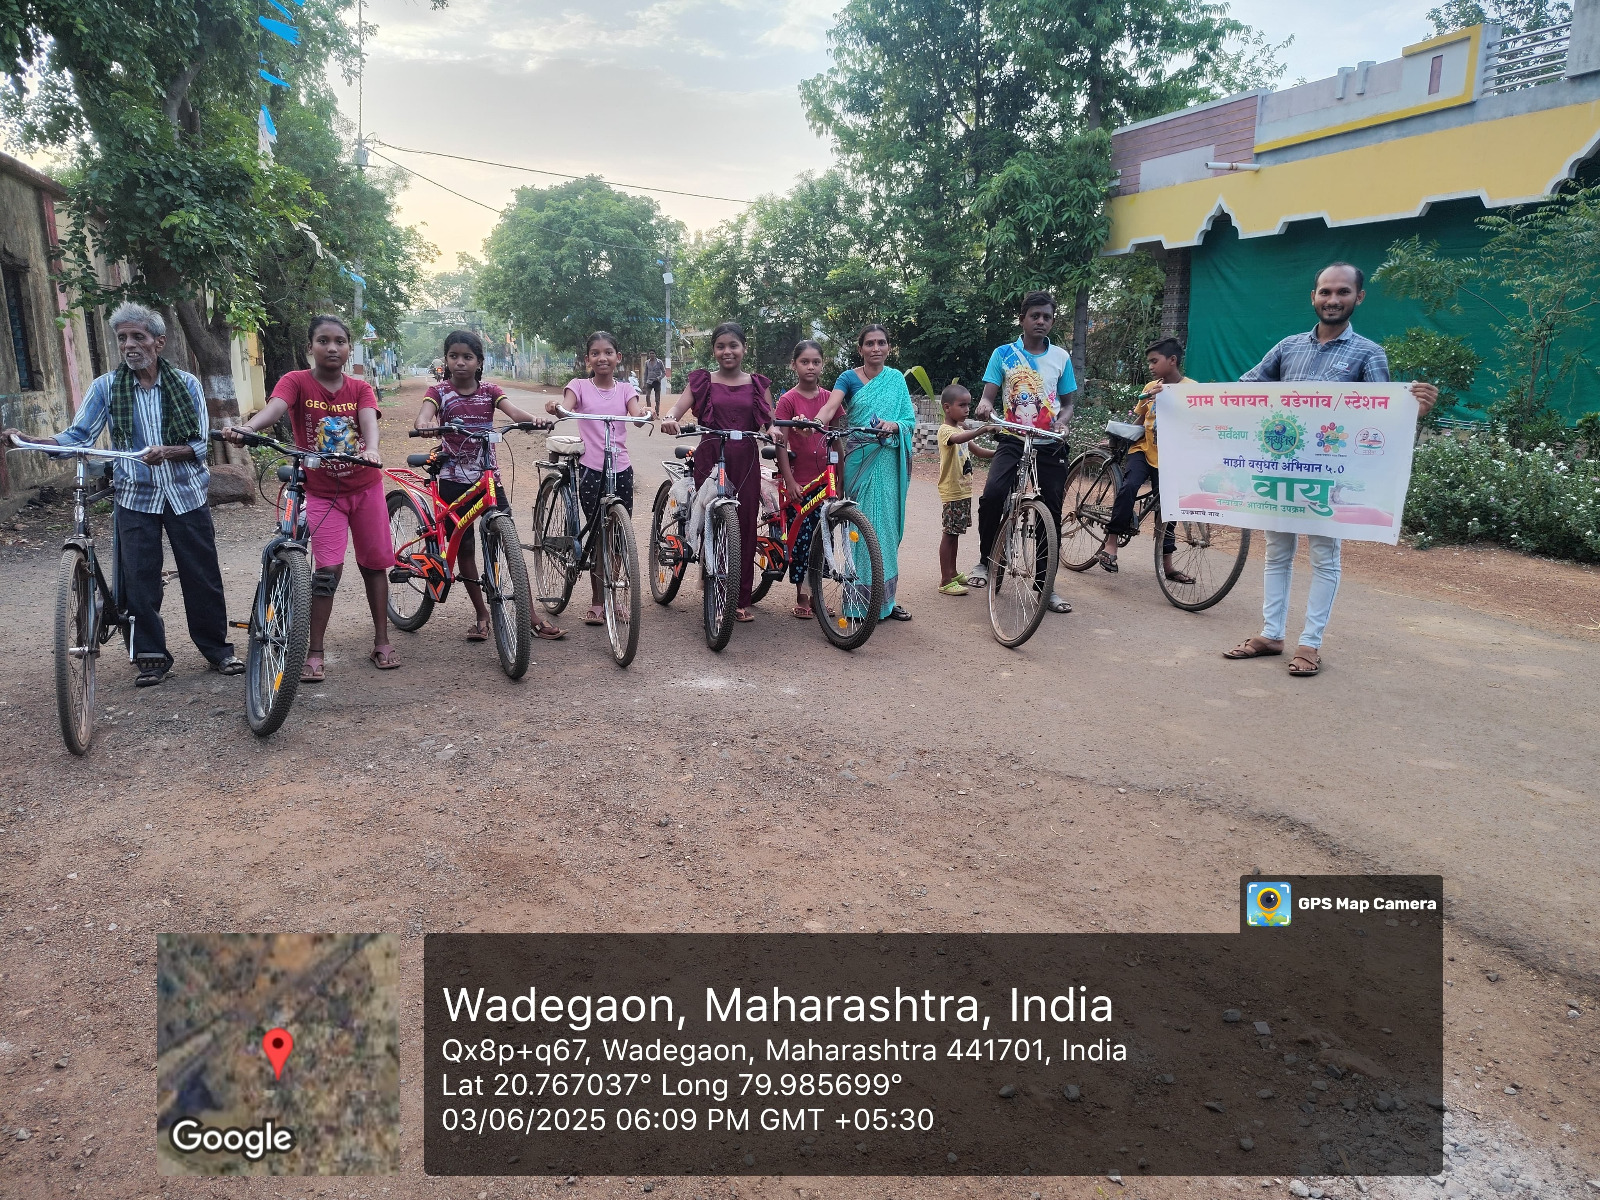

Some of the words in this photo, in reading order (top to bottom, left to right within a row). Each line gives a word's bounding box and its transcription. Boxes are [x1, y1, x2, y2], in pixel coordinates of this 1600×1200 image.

[1186, 394, 1214, 409] ग्राम
[1219, 391, 1274, 409] पंचायत,
[1217, 426, 1249, 440] सर्वेक्षण
[1223, 455, 1245, 468] माझी
[1248, 457, 1279, 473] वसुंधरा
[1282, 458, 1323, 473] अभियान
[1251, 474, 1335, 517] वायु
[1280, 505, 1306, 513] उपक्रम
